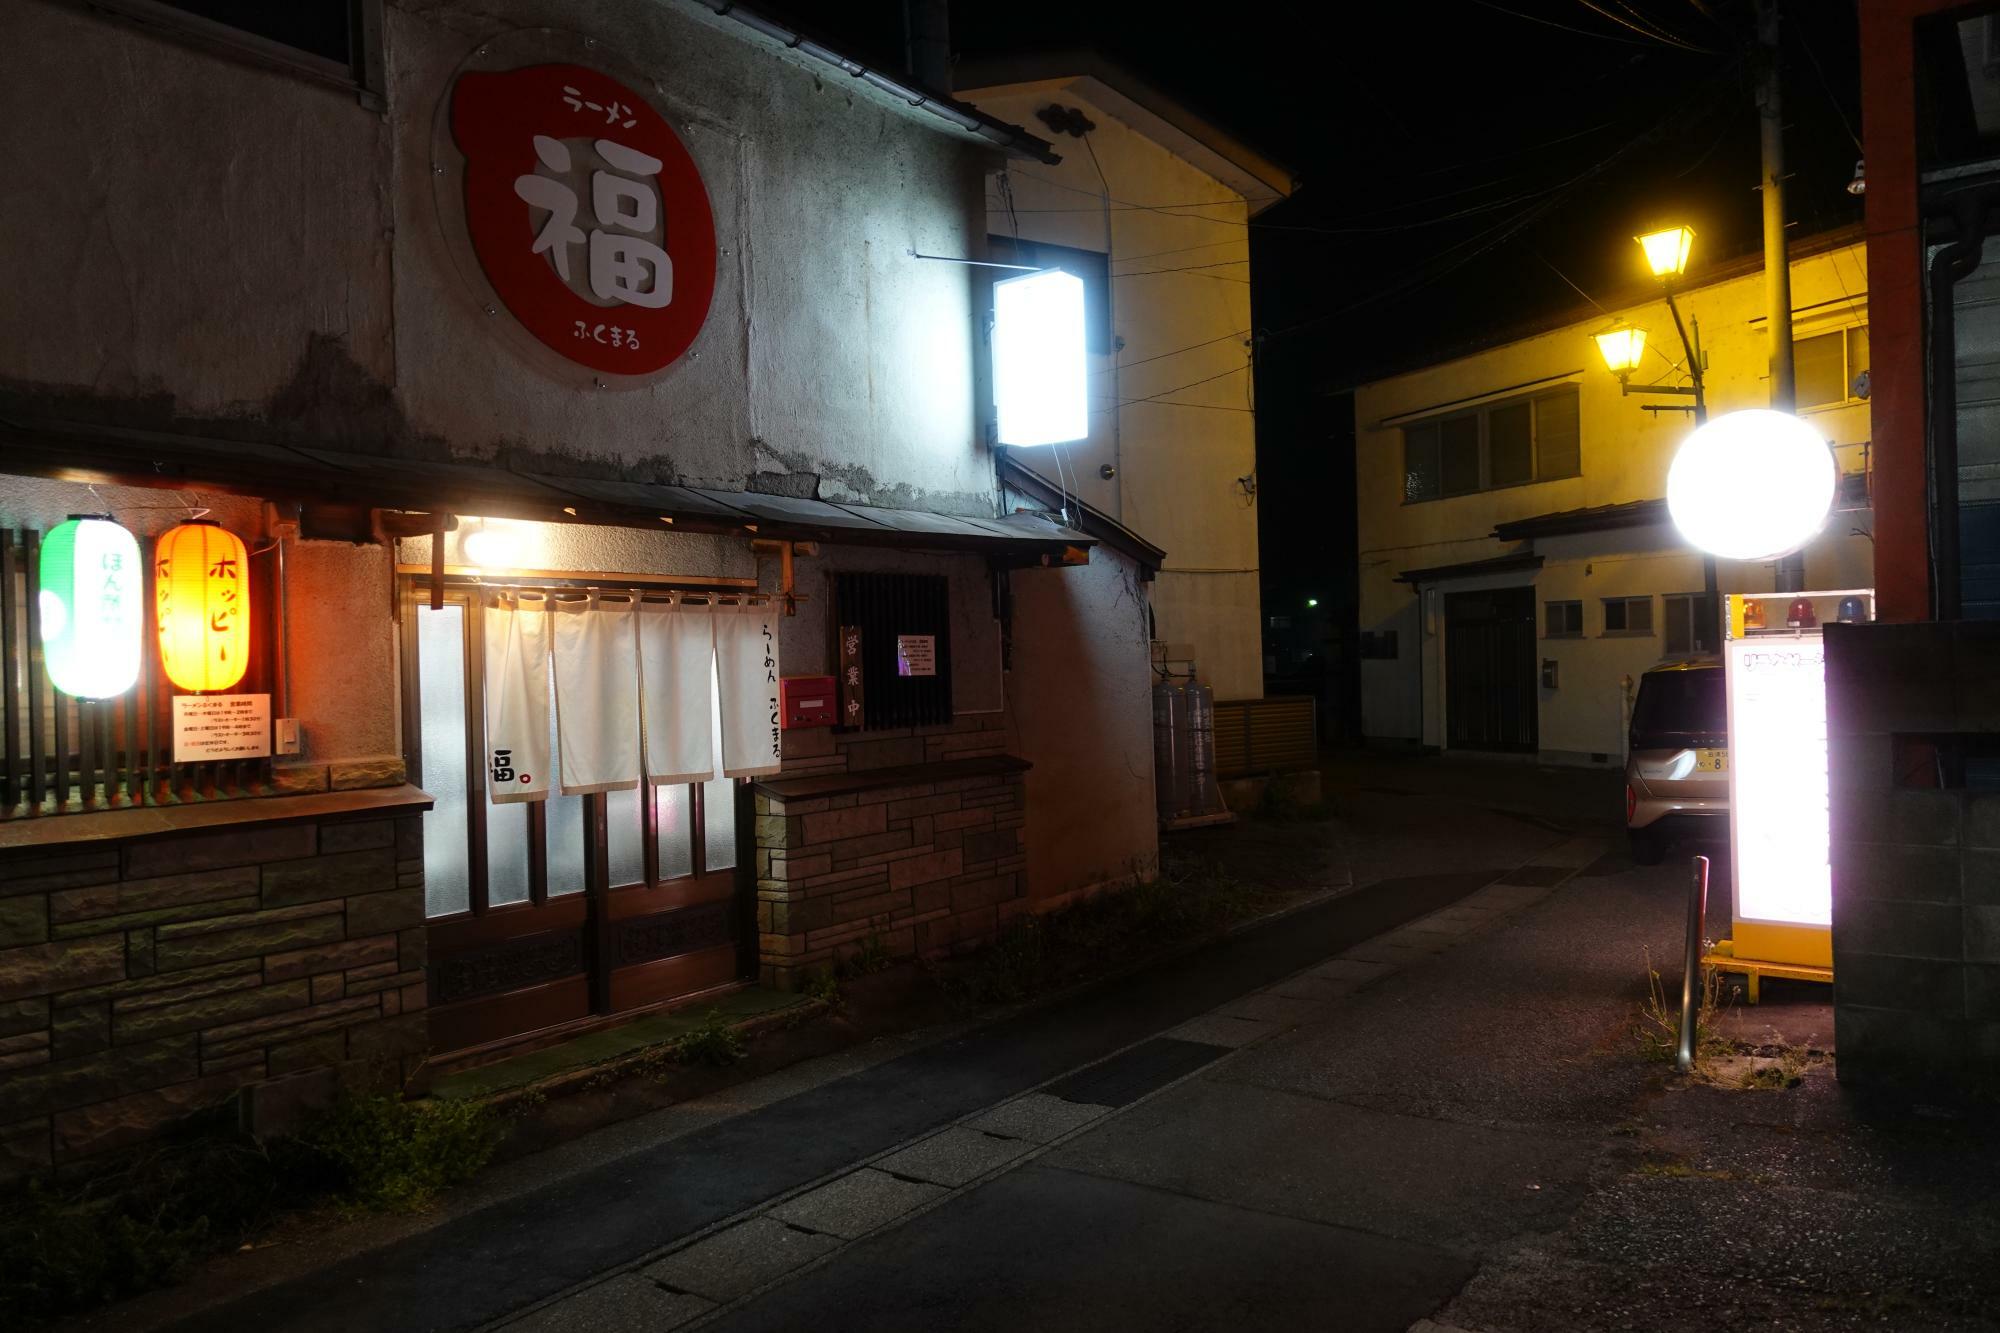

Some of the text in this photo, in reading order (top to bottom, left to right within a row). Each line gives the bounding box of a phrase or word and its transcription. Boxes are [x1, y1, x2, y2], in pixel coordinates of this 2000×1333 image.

[562, 85, 637, 128] ラーメン
[513, 134, 674, 309] 福
[574, 320, 640, 350] ふくまる
[209, 553, 238, 662] ホッピー
[762, 623, 782, 758] らーめん ふくまる
[846, 635, 861, 718] 営業中
